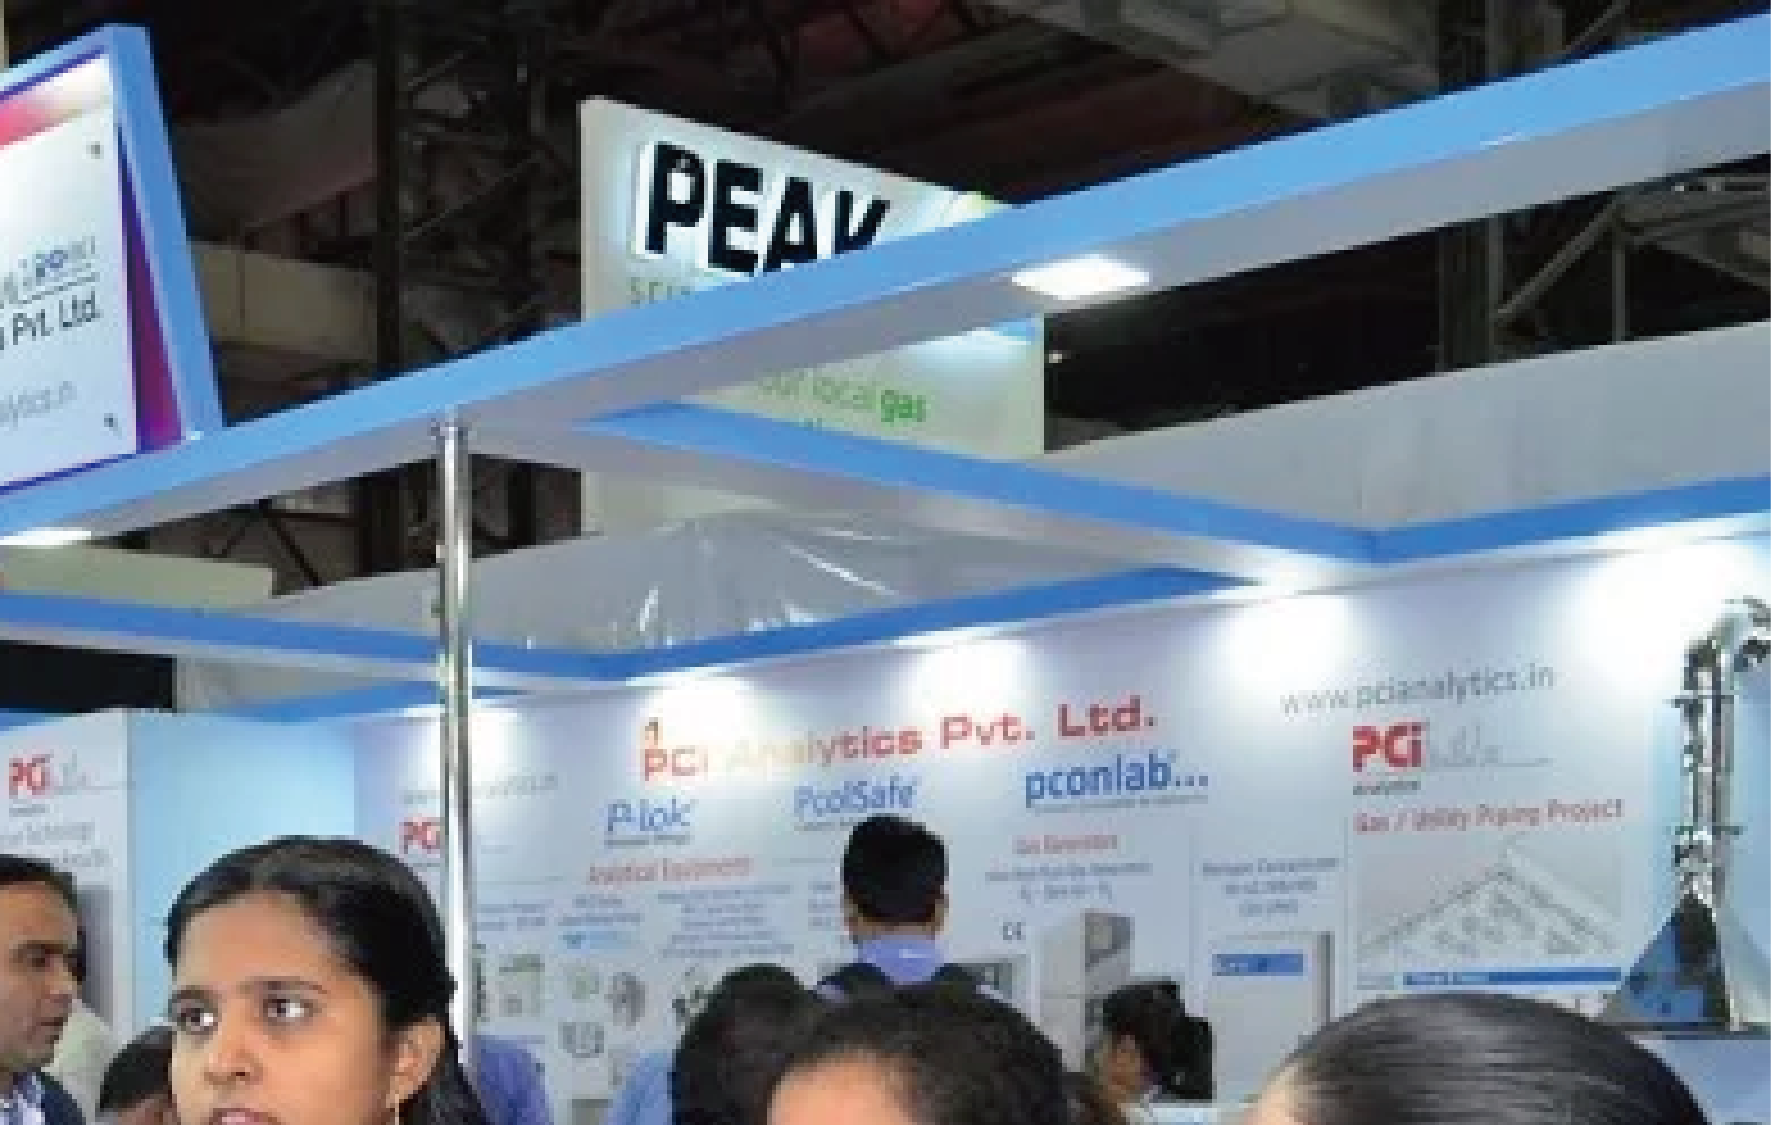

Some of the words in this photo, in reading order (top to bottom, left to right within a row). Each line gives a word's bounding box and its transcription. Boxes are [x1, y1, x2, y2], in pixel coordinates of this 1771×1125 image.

[1280, 664, 1554, 715] www.pcianalytics.in
[940, 712, 1035, 748] Pvt.
[1058, 696, 1157, 738] Ltd.
